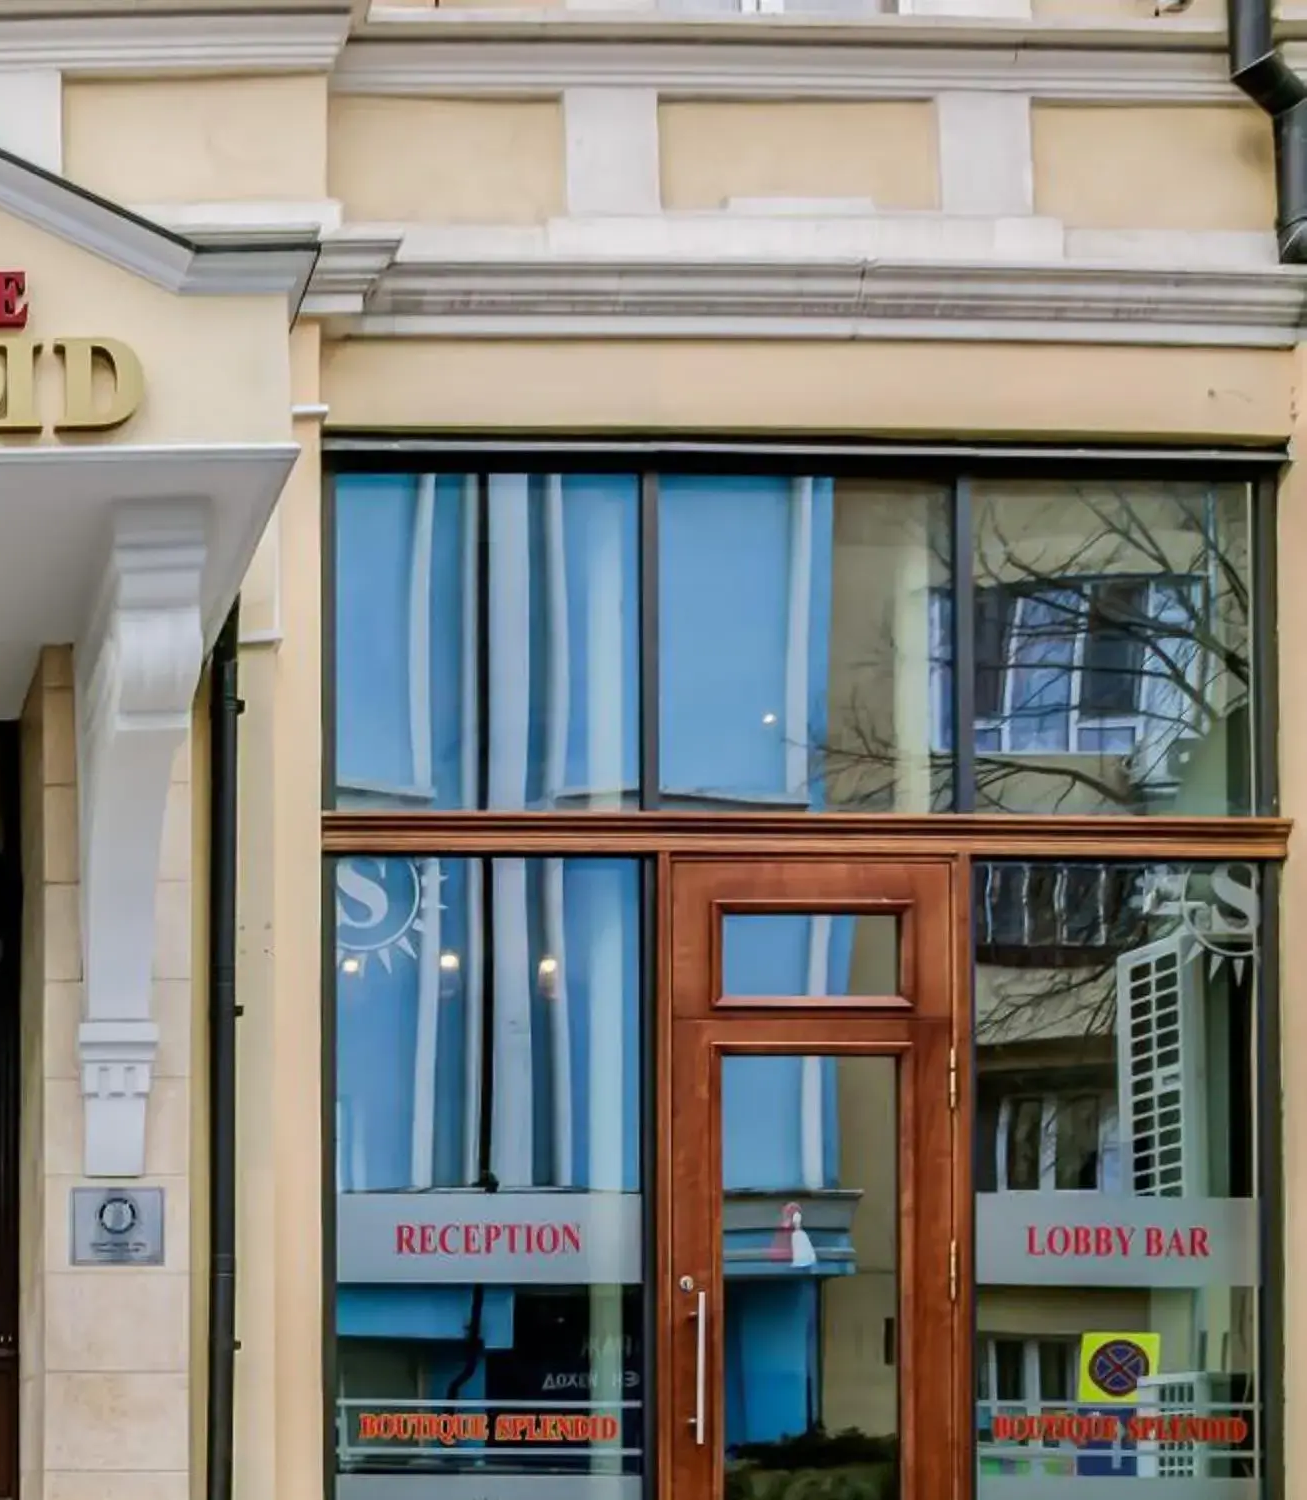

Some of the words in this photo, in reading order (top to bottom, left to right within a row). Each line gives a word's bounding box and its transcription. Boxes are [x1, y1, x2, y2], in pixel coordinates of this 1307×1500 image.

[396, 1223, 582, 1255] RECEPTION
[1026, 1226, 1136, 1257] LOBBY
[1145, 1227, 1211, 1258] BAR
[359, 1412, 489, 1446] BOUTIQUE
[494, 1413, 619, 1442] SPLENDID
[993, 1414, 1119, 1446] BOUTIQUE
[1128, 1415, 1248, 1444] SPLENDID
